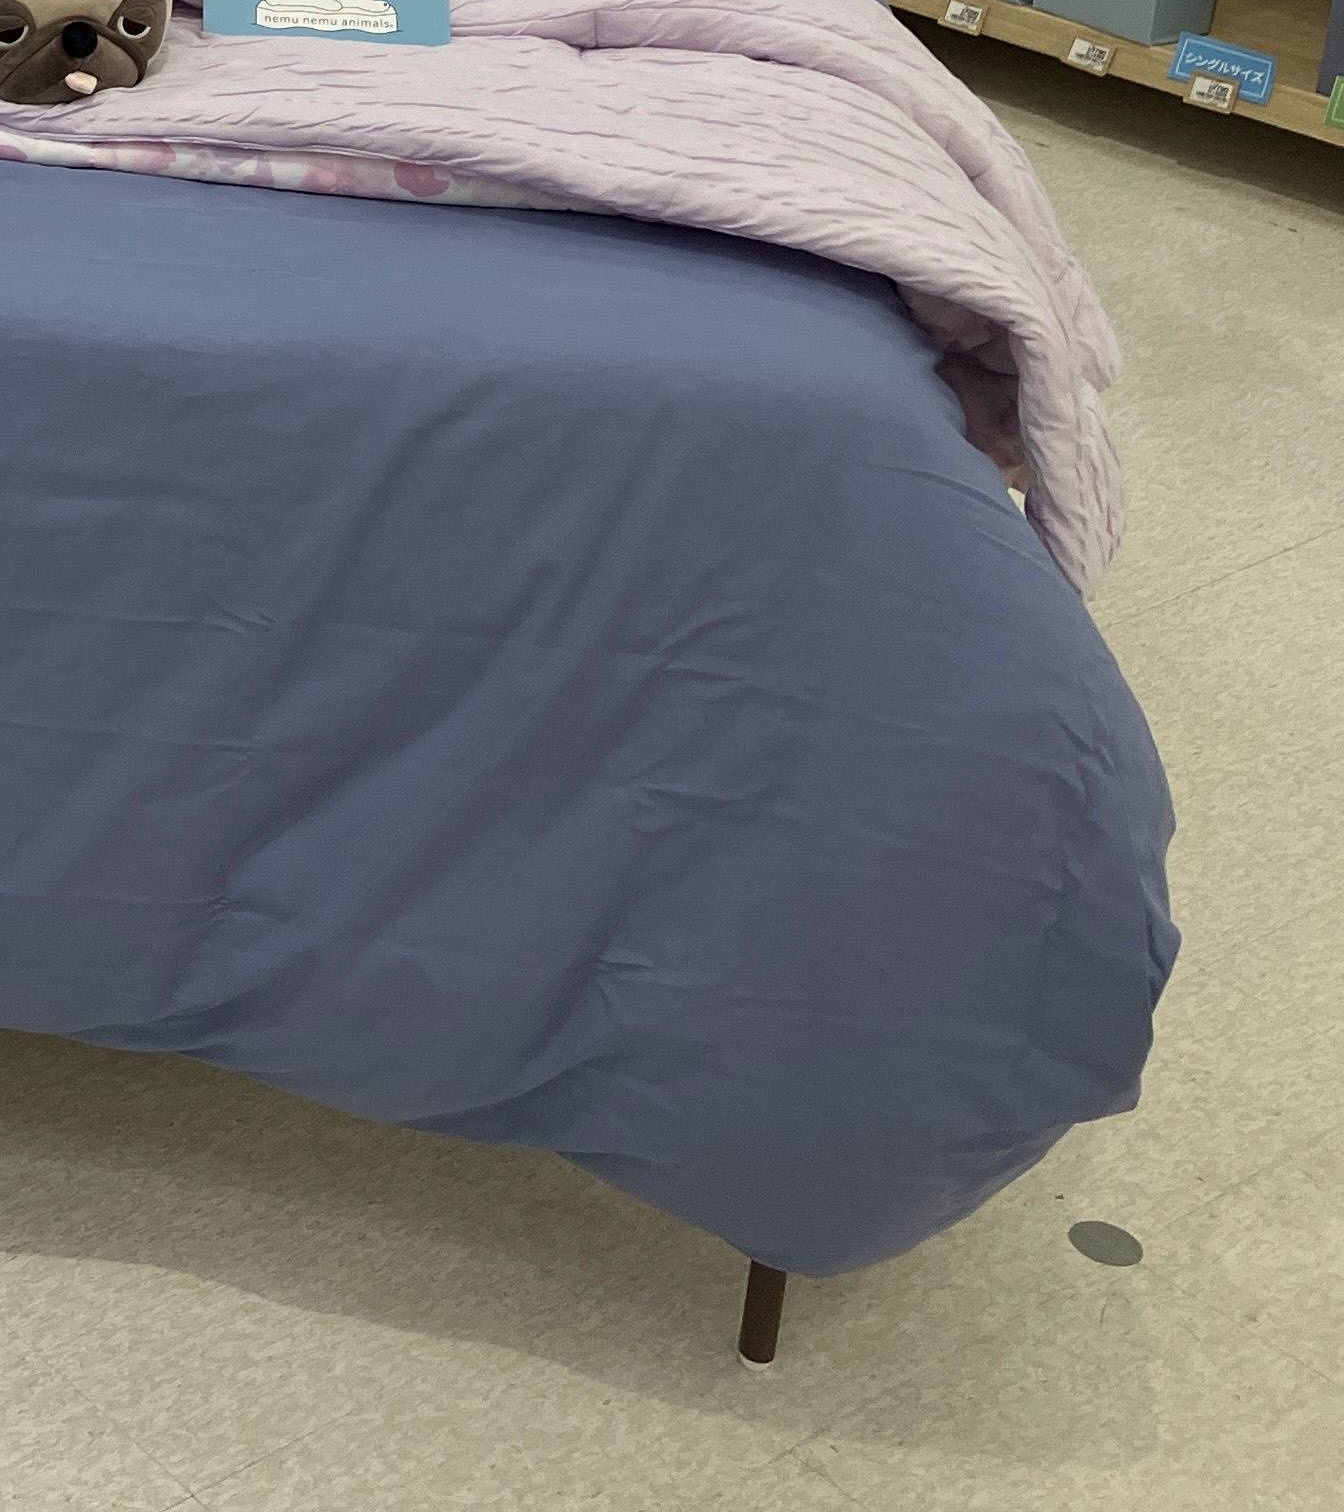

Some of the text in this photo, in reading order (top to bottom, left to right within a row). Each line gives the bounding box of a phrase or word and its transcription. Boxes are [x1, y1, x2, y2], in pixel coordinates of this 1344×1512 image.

[263, 14, 300, 25] nemu
[301, 16, 338, 26] nemu
[1184, 50, 1265, 85] シングルサイズ
